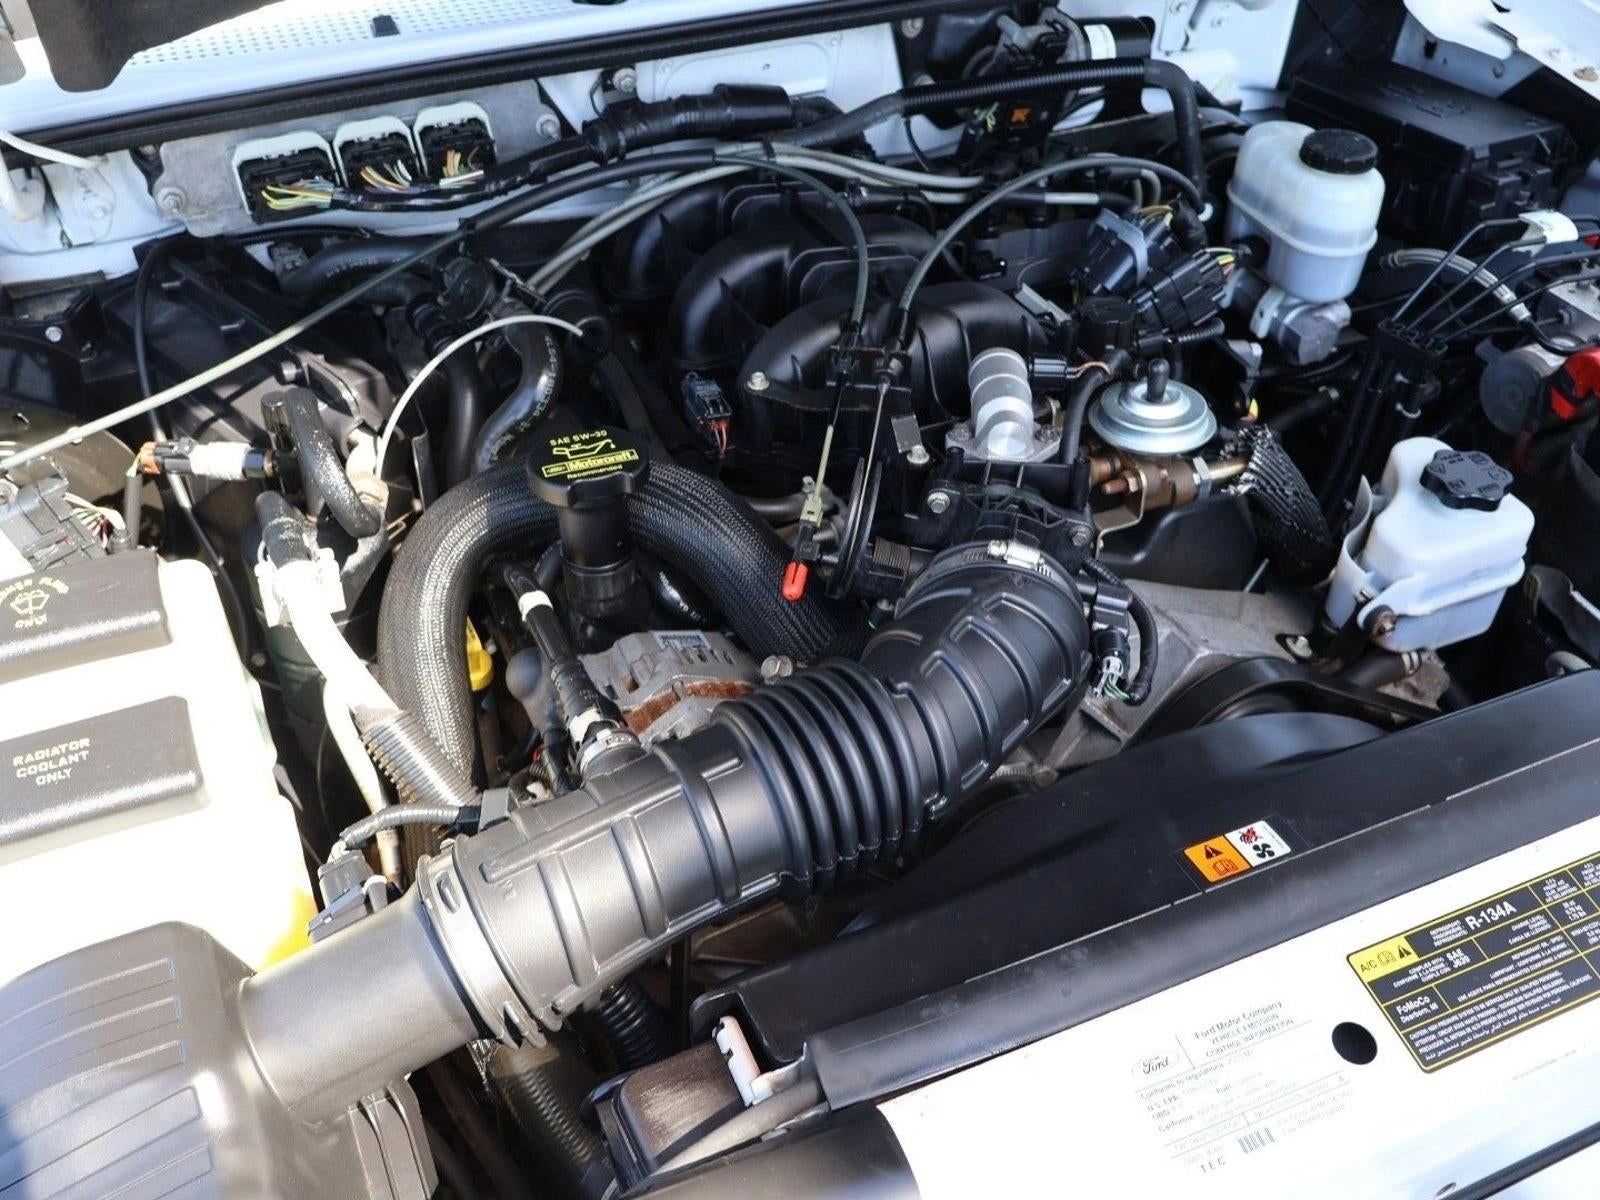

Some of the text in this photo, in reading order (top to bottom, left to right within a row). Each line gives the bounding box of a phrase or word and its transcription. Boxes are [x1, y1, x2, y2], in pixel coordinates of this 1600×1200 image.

[549, 437, 571, 447] SAE
[569, 451, 632, 472] Motorcraft
[567, 464, 624, 479] Recommended
[13, 738, 91, 767] RADIATOR
[16, 750, 90, 778] COOLANT
[35, 767, 73, 786] ONLY
[1465, 901, 1517, 930] R-134A
[1446, 948, 1465, 962] SAE
[1359, 959, 1377, 973] A/C
[1396, 996, 1431, 1015] FoMoCo
[1194, 1000, 1283, 1041] Ford Motor Company
[1400, 1007, 1431, 1024] Dearborn,
[1142, 1055, 1170, 1075] Ford
